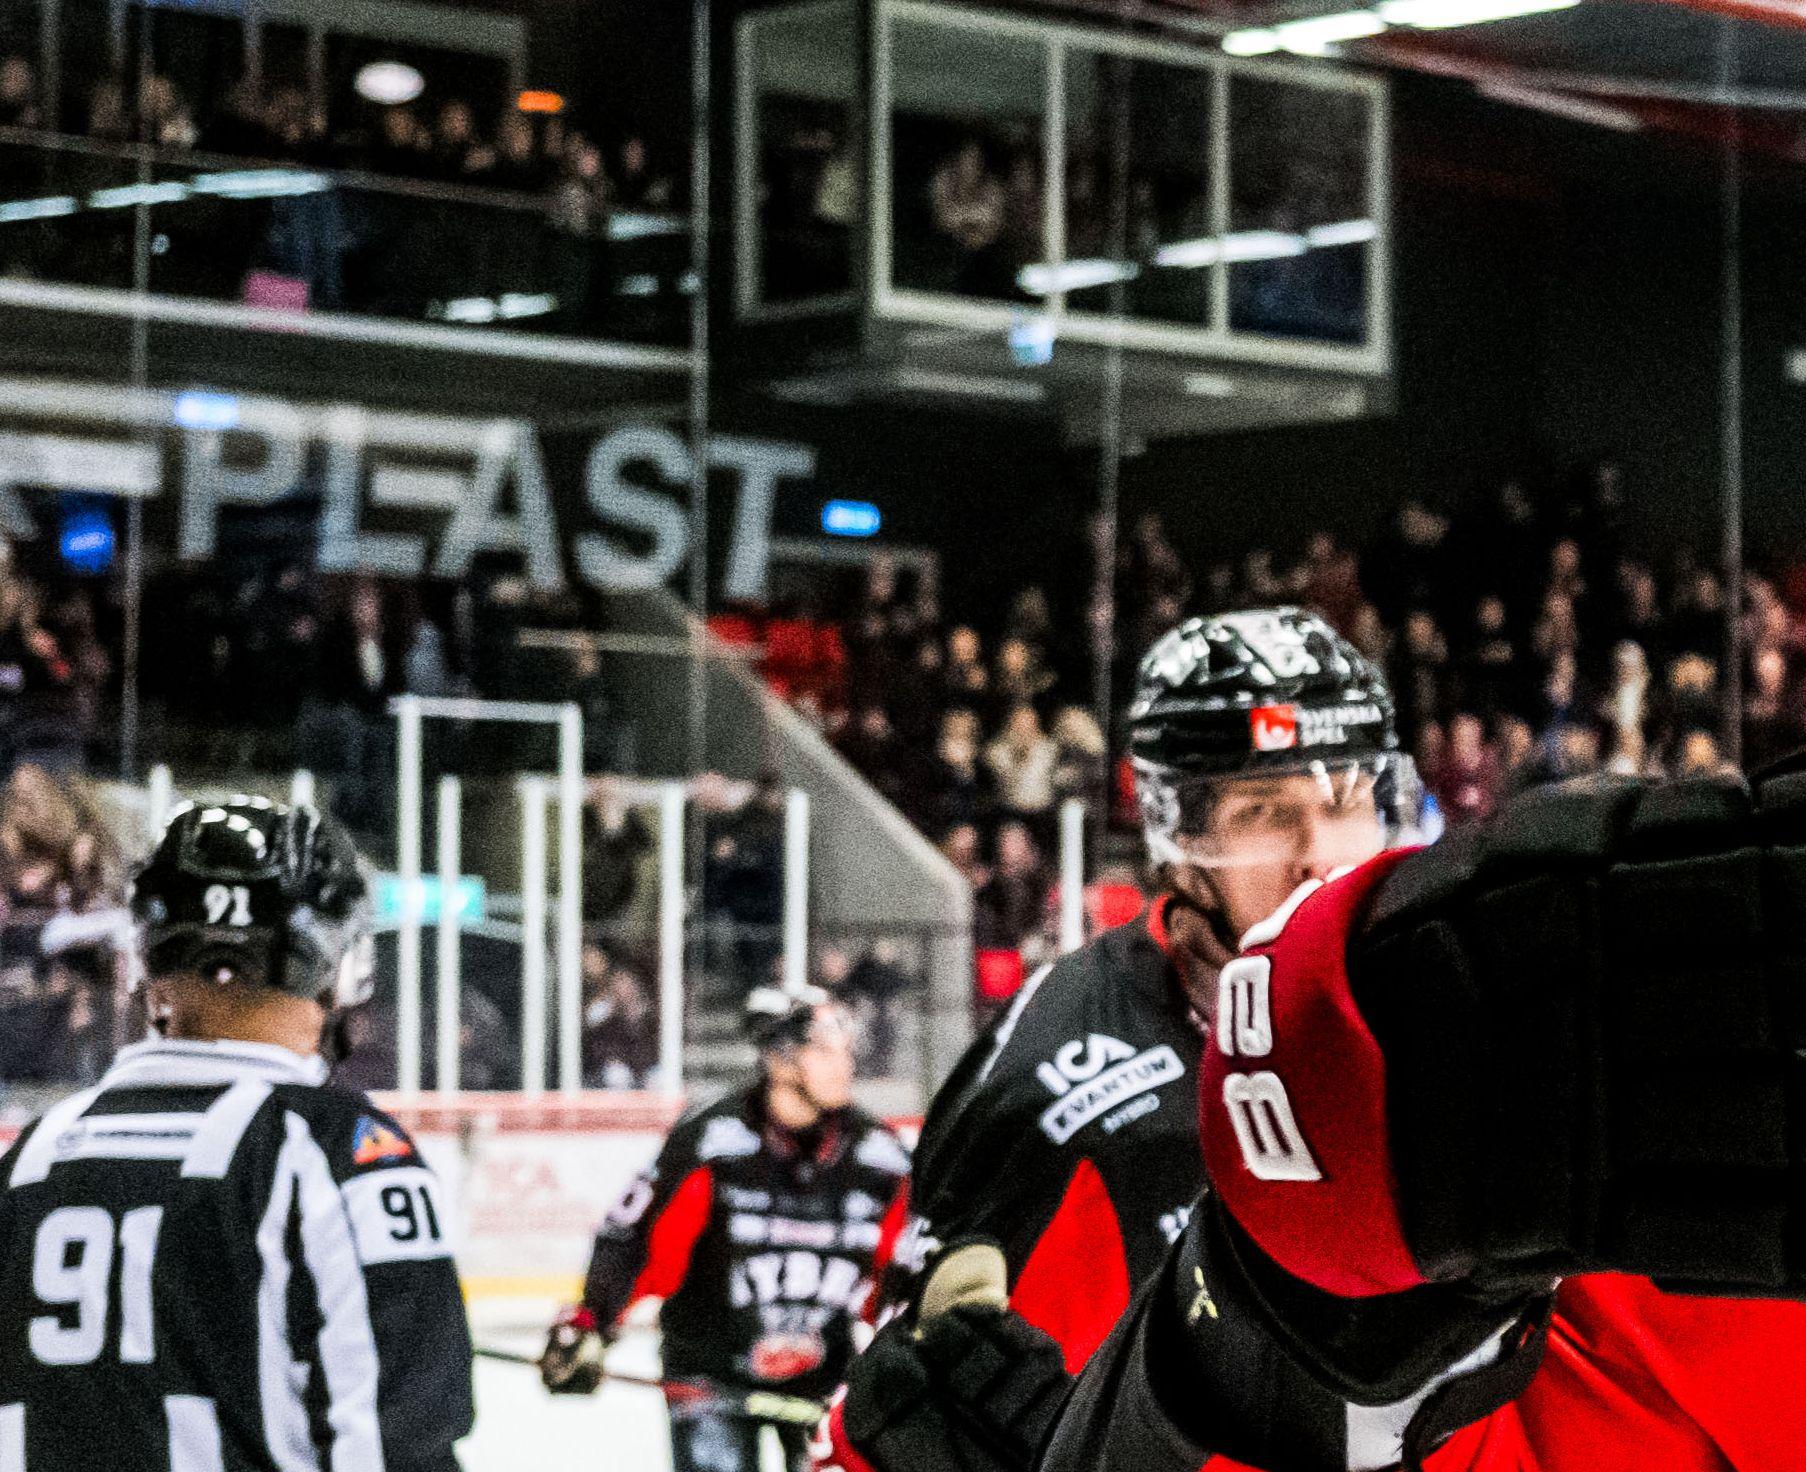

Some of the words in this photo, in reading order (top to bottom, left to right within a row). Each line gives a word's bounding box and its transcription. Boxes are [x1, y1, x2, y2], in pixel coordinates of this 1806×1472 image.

[204, 884, 252, 926] 91
[1036, 1033, 1138, 1098] ICA
[381, 1184, 441, 1242] 91
[28, 1205, 163, 1366] 91
